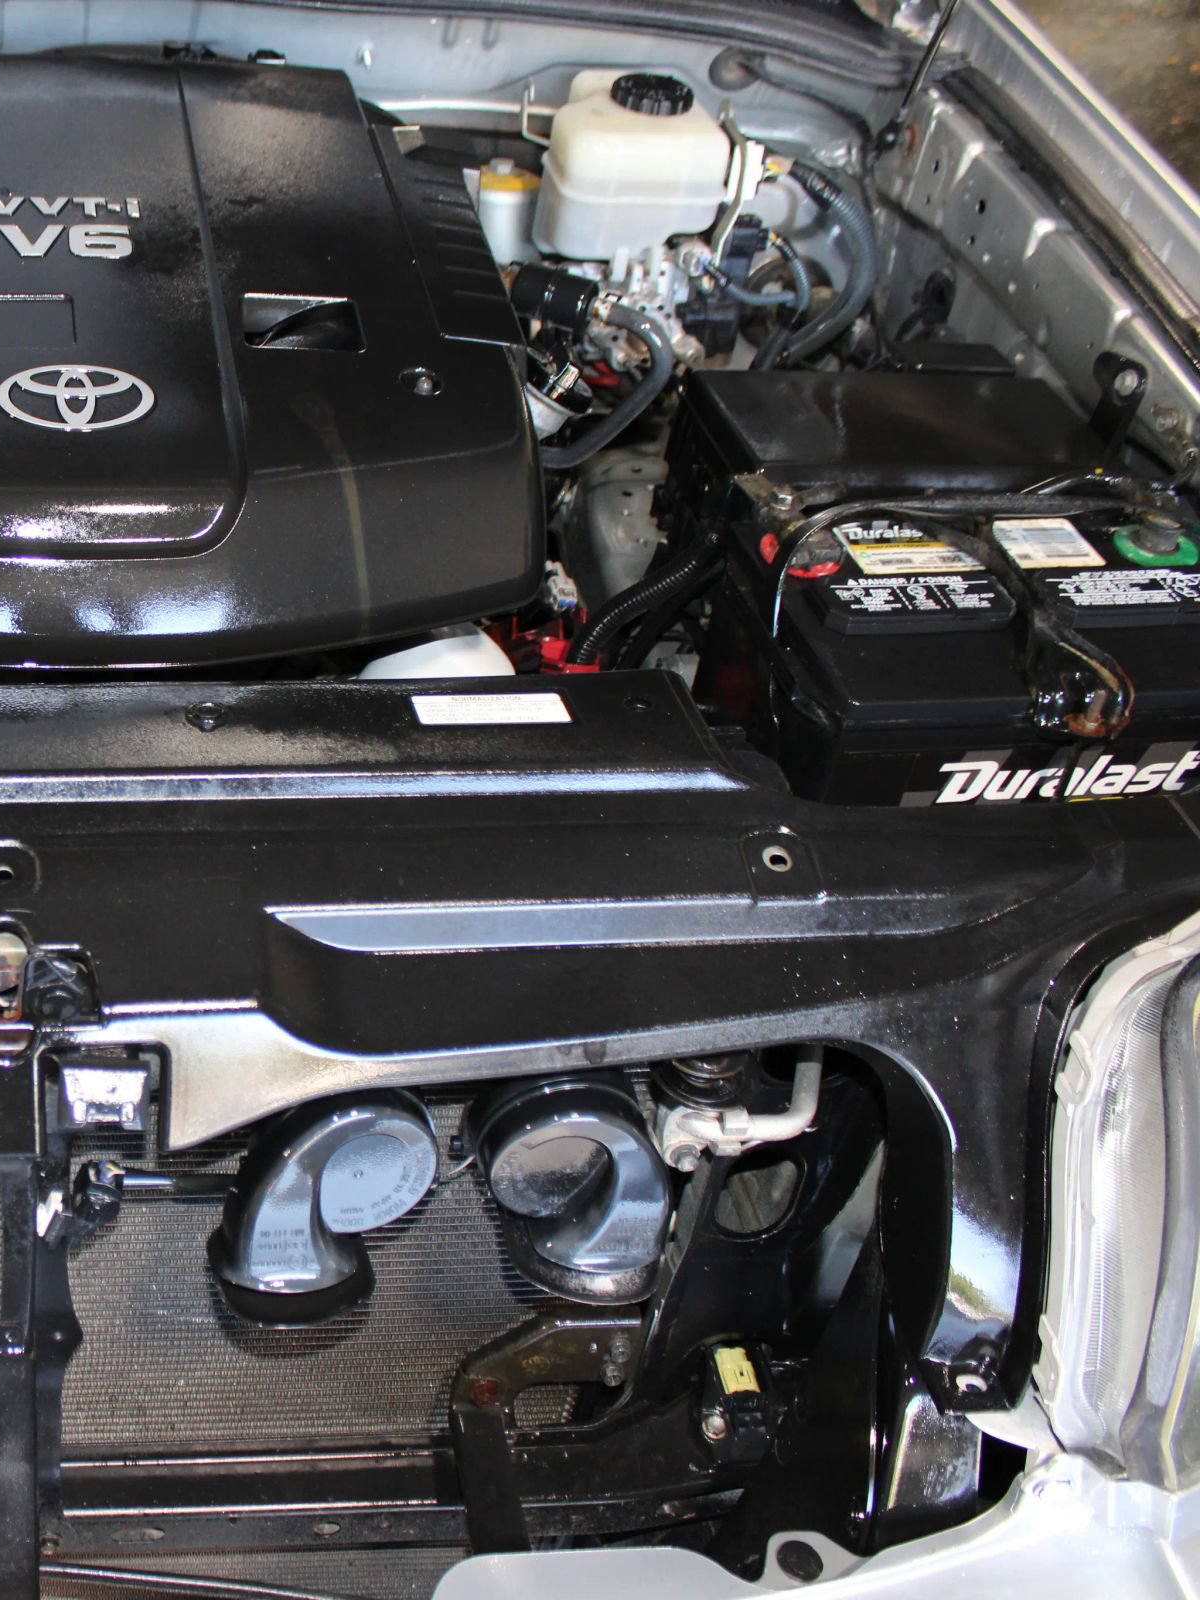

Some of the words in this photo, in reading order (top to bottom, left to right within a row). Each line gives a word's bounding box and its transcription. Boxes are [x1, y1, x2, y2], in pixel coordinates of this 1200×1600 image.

[841, 526, 923, 540] Duralas
[917, 576, 963, 584] POISON
[935, 750, 1200, 804] Duralast
